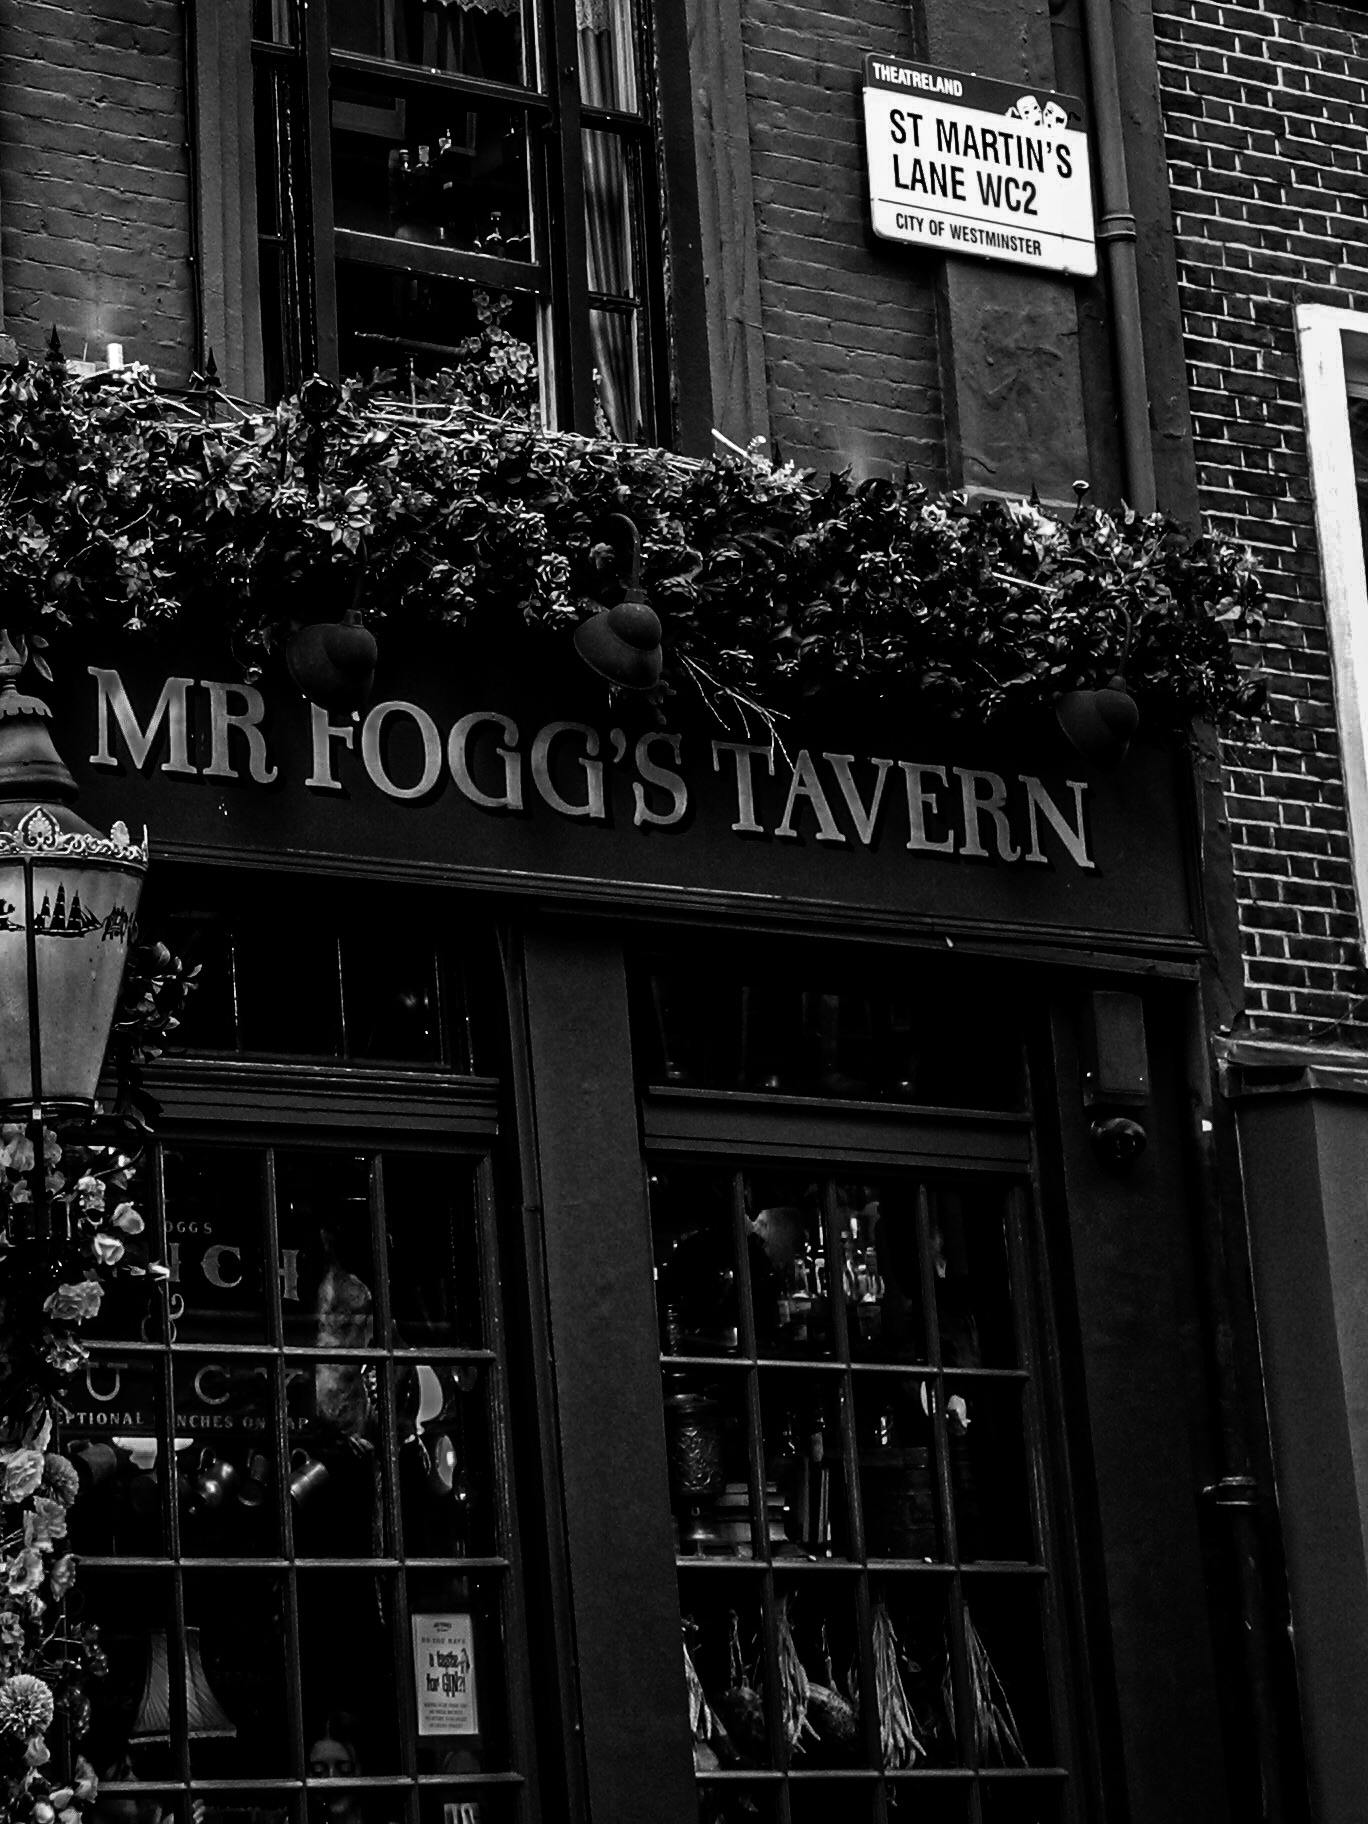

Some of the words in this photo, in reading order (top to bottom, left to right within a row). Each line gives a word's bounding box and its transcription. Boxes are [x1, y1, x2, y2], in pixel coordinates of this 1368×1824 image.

[872, 62, 963, 97] THEATRELAND
[889, 108, 923, 147] ST
[935, 117, 1073, 179] MARTIN'S
[892, 153, 967, 201] LANE
[975, 169, 1038, 216] WC2
[895, 212, 924, 233] CITY
[929, 219, 946, 237] OF
[949, 223, 1042, 256] WESTMINSTER
[87, 666, 278, 784] MR
[710, 738, 1096, 869] TAVERN
